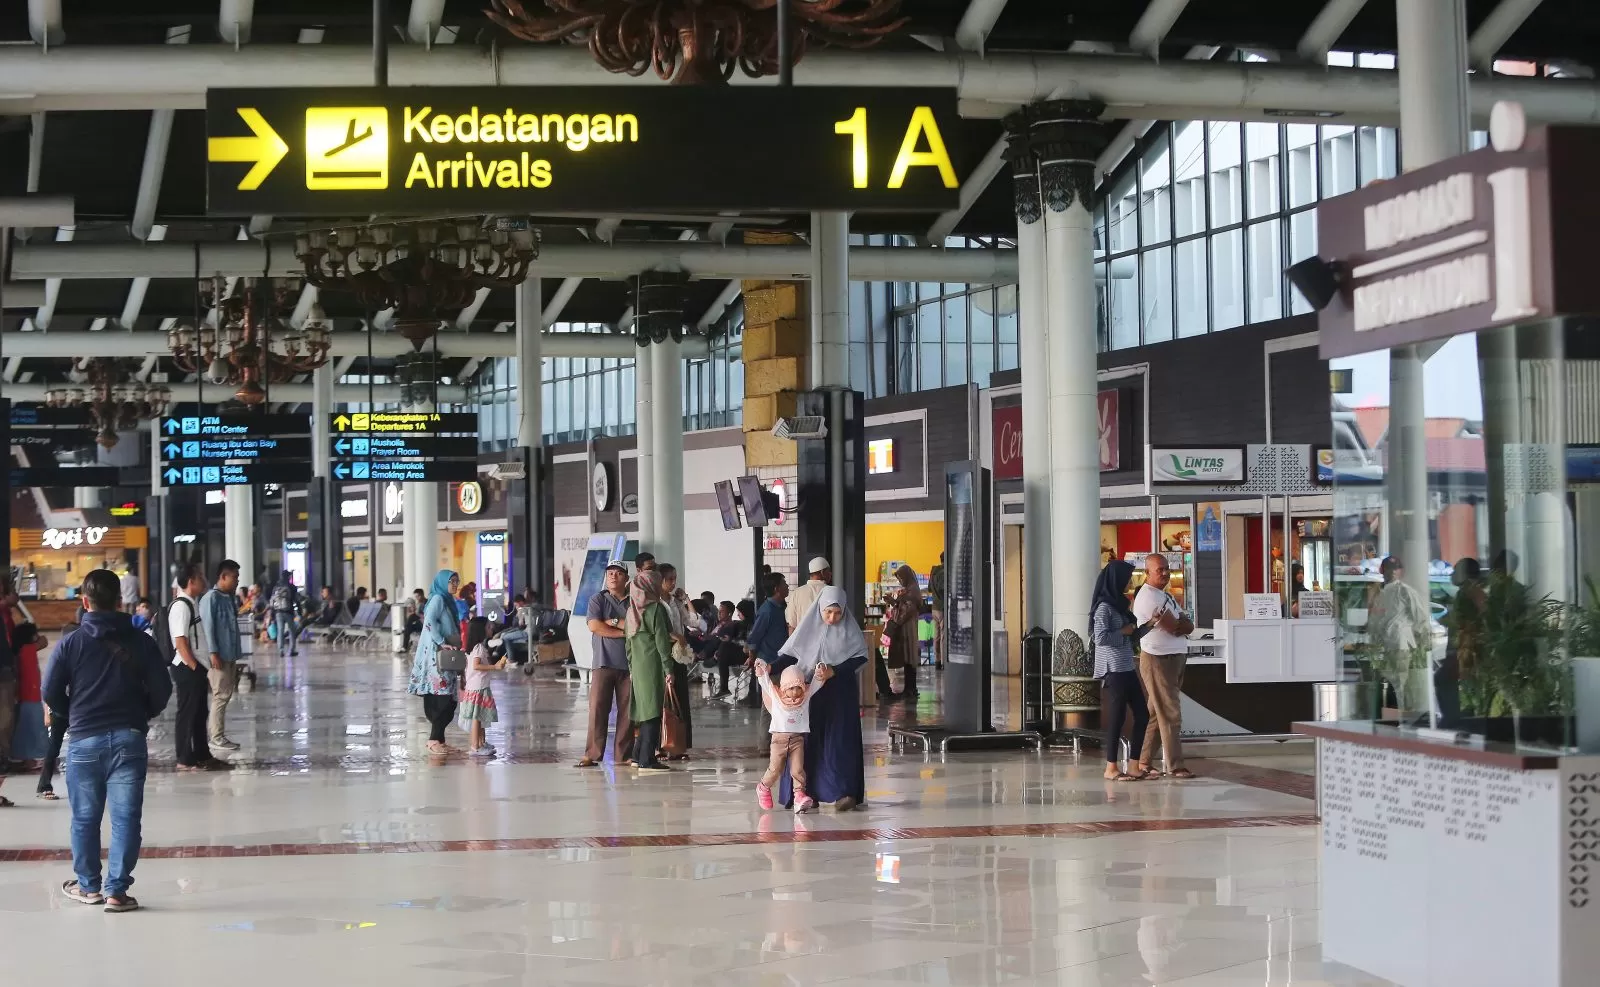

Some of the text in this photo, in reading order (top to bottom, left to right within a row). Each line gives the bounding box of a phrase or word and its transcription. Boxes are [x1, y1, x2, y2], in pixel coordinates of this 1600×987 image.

[403, 106, 960, 188] Kedatangan 1A
[404, 151, 553, 188] Arrivals
[1364, 172, 1475, 251] INFORMASI
[1353, 253, 1490, 332] INFORMATION
[201, 417, 220, 425] ATM
[371, 413, 441, 423] Keberangkatan 1A
[201, 425, 248, 434] ATM Center
[371, 422, 426, 432] Departures 1A
[201, 440, 228, 449] Ruang
[242, 440, 258, 448] dan
[259, 440, 277, 449] Bayi
[371, 438, 405, 447] Musholla
[201, 449, 258, 459] Nursery Room
[371, 447, 420, 457] Prayer Room
[371, 461, 425, 470] Area Merokok
[1184, 457, 1225, 468] LINTAS
[221, 466, 243, 474] Toilet
[221, 474, 248, 483] Toilets
[371, 471, 425, 480] Smoking Area
[41, 527, 83, 550] Roti
